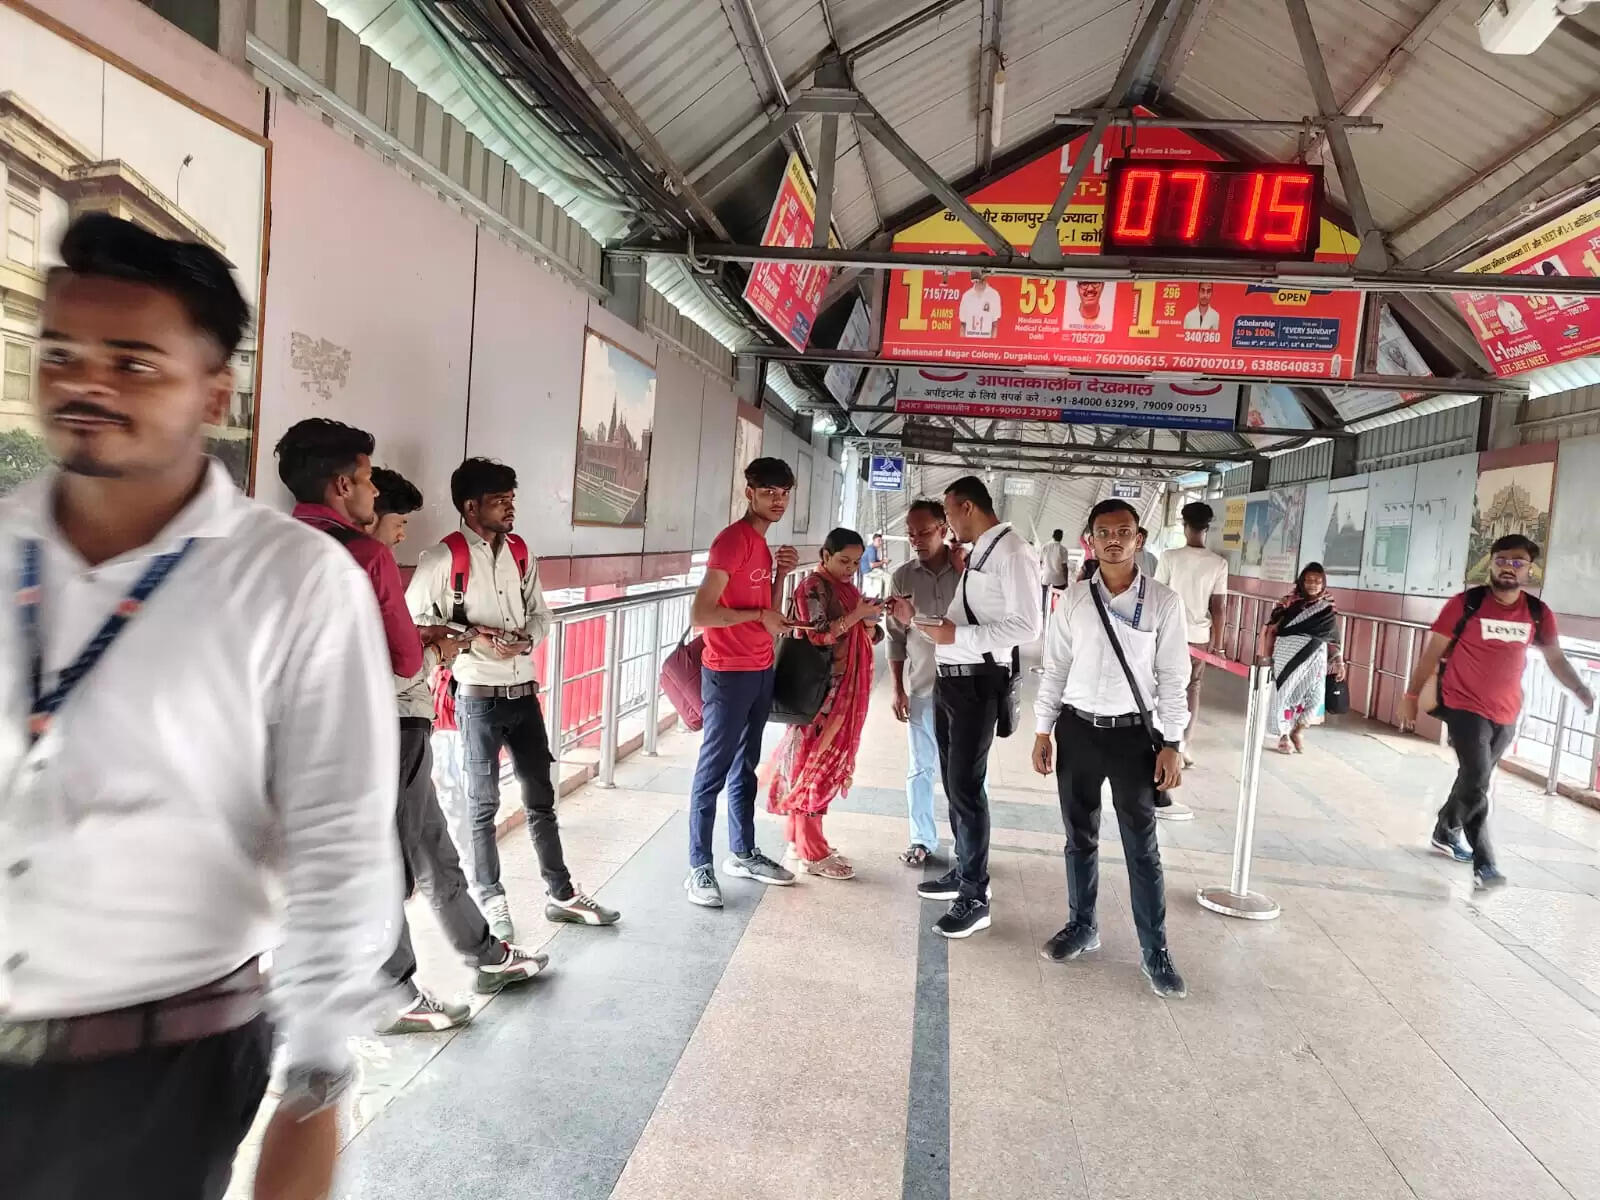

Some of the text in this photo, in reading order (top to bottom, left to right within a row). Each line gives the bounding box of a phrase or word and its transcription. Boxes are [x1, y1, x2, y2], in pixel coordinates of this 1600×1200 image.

[1116, 170, 1309, 242] 07 15
[1001, 212, 1045, 229] कानपुर
[923, 287, 960, 301] 715/720
[1019, 278, 1058, 316] 53
[1277, 291, 1308, 303] OPEN
[930, 308, 954, 319] AIIMS
[1164, 304, 1176, 317] 35
[931, 319, 952, 330] Delhi
[1237, 319, 1276, 329] Scholarship
[1184, 330, 1221, 344] 340/360
[893, 348, 943, 357] Brahmanand
[945, 350, 969, 360] Nagar
[971, 351, 1001, 360] Colony,
[1096, 354, 1168, 369] 7607006615,
[1172, 357, 1248, 373] 7607007019,
[1251, 359, 1325, 374] 6388640833
[1087, 378, 1156, 397] देखभाल
[980, 406, 1027, 416] +91-90903
[1051, 395, 1102, 407] +91-84000
[1105, 400, 1138, 411] 63299,
[1142, 401, 1174, 411] 79009
[1176, 403, 1208, 414] 00953
